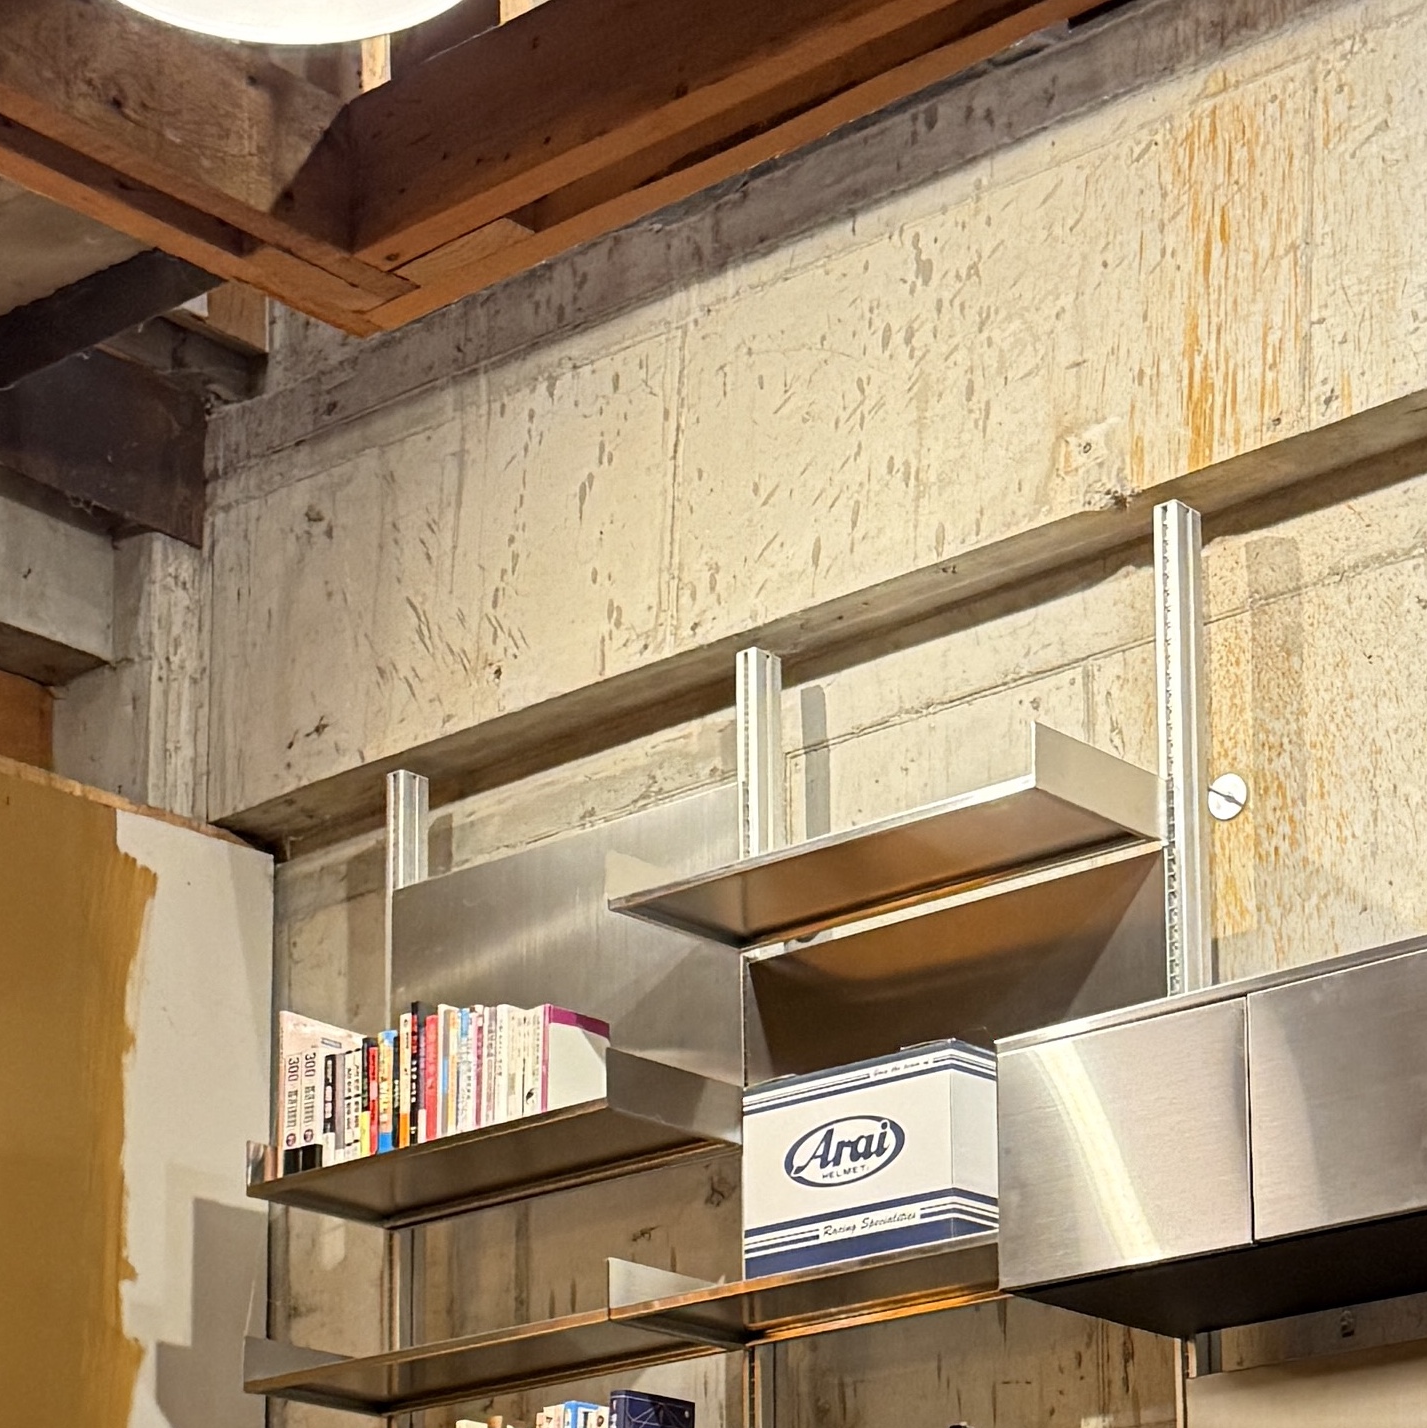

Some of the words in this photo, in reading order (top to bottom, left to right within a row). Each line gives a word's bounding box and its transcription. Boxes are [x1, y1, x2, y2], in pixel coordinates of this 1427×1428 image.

[287, 1056, 300, 1083] 300
[791, 1120, 891, 1177] Arai
[822, 1165, 867, 1180] HELMET
[823, 1222, 857, 1239] Racing
